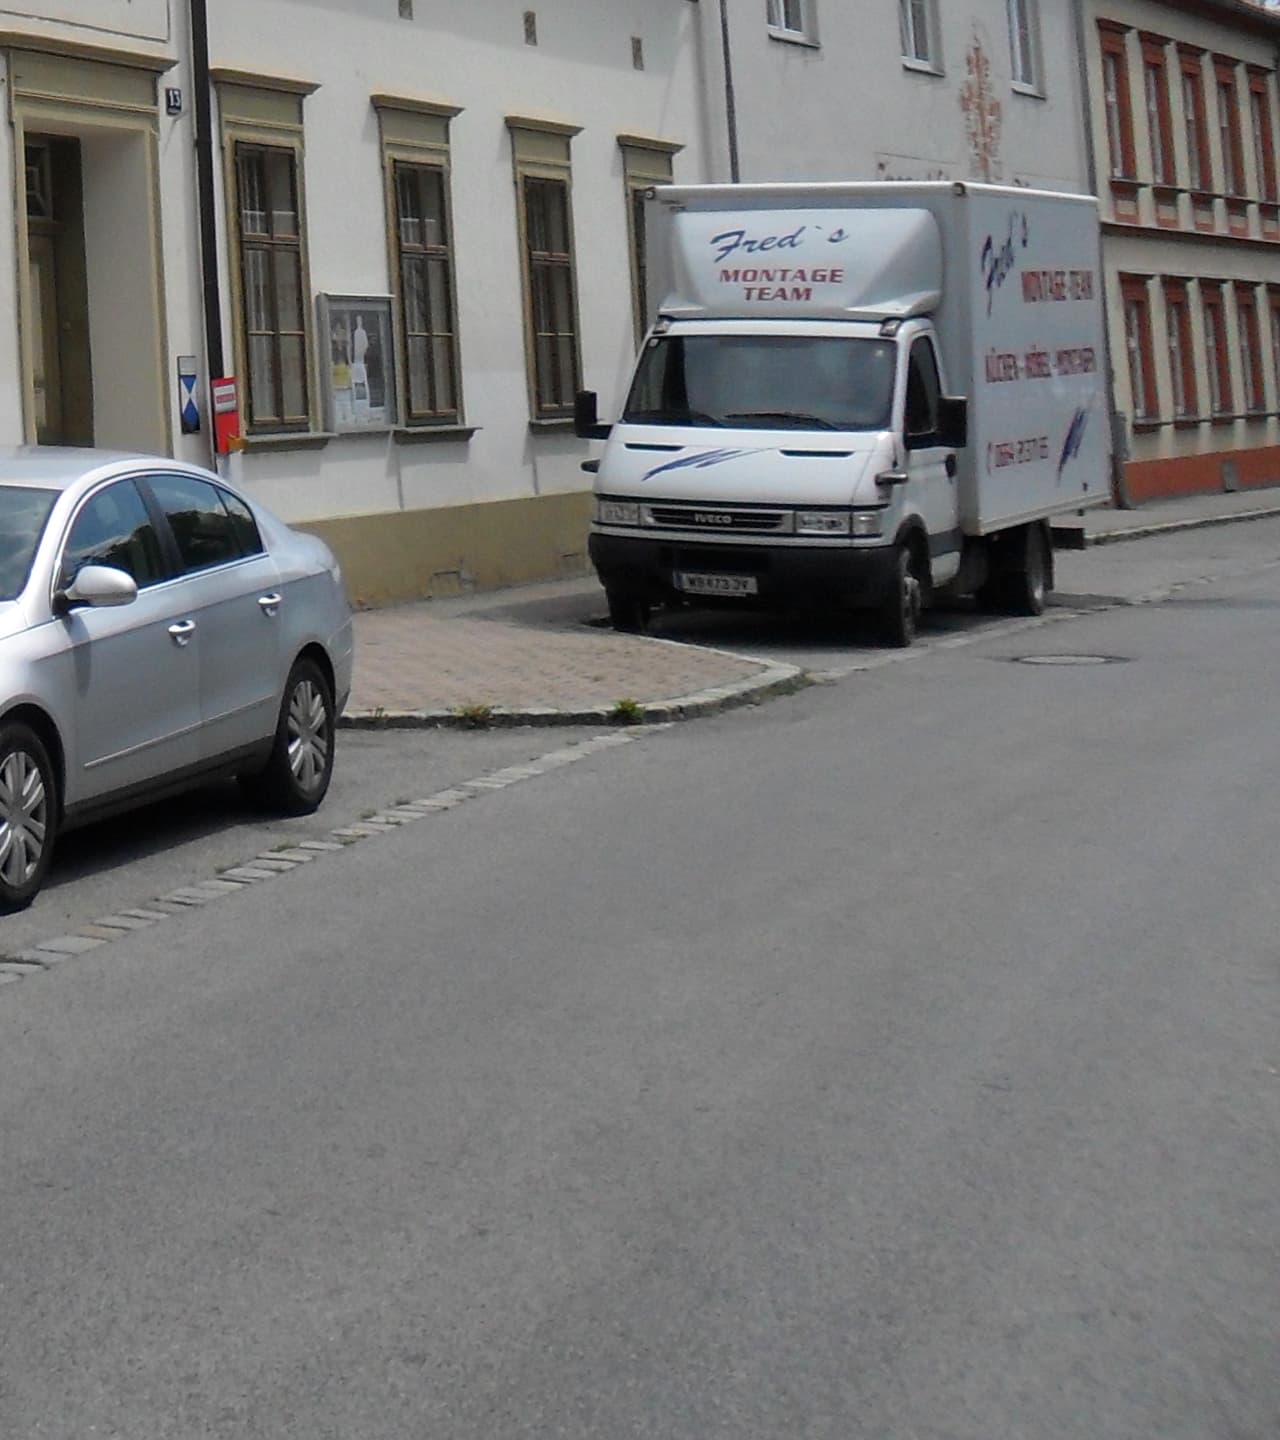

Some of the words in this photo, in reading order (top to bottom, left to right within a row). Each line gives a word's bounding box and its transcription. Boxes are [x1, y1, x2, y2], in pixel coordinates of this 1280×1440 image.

[720, 268, 844, 283] MONTAGE
[744, 287, 813, 301] TEAM
[694, 513, 733, 524] IVECO
